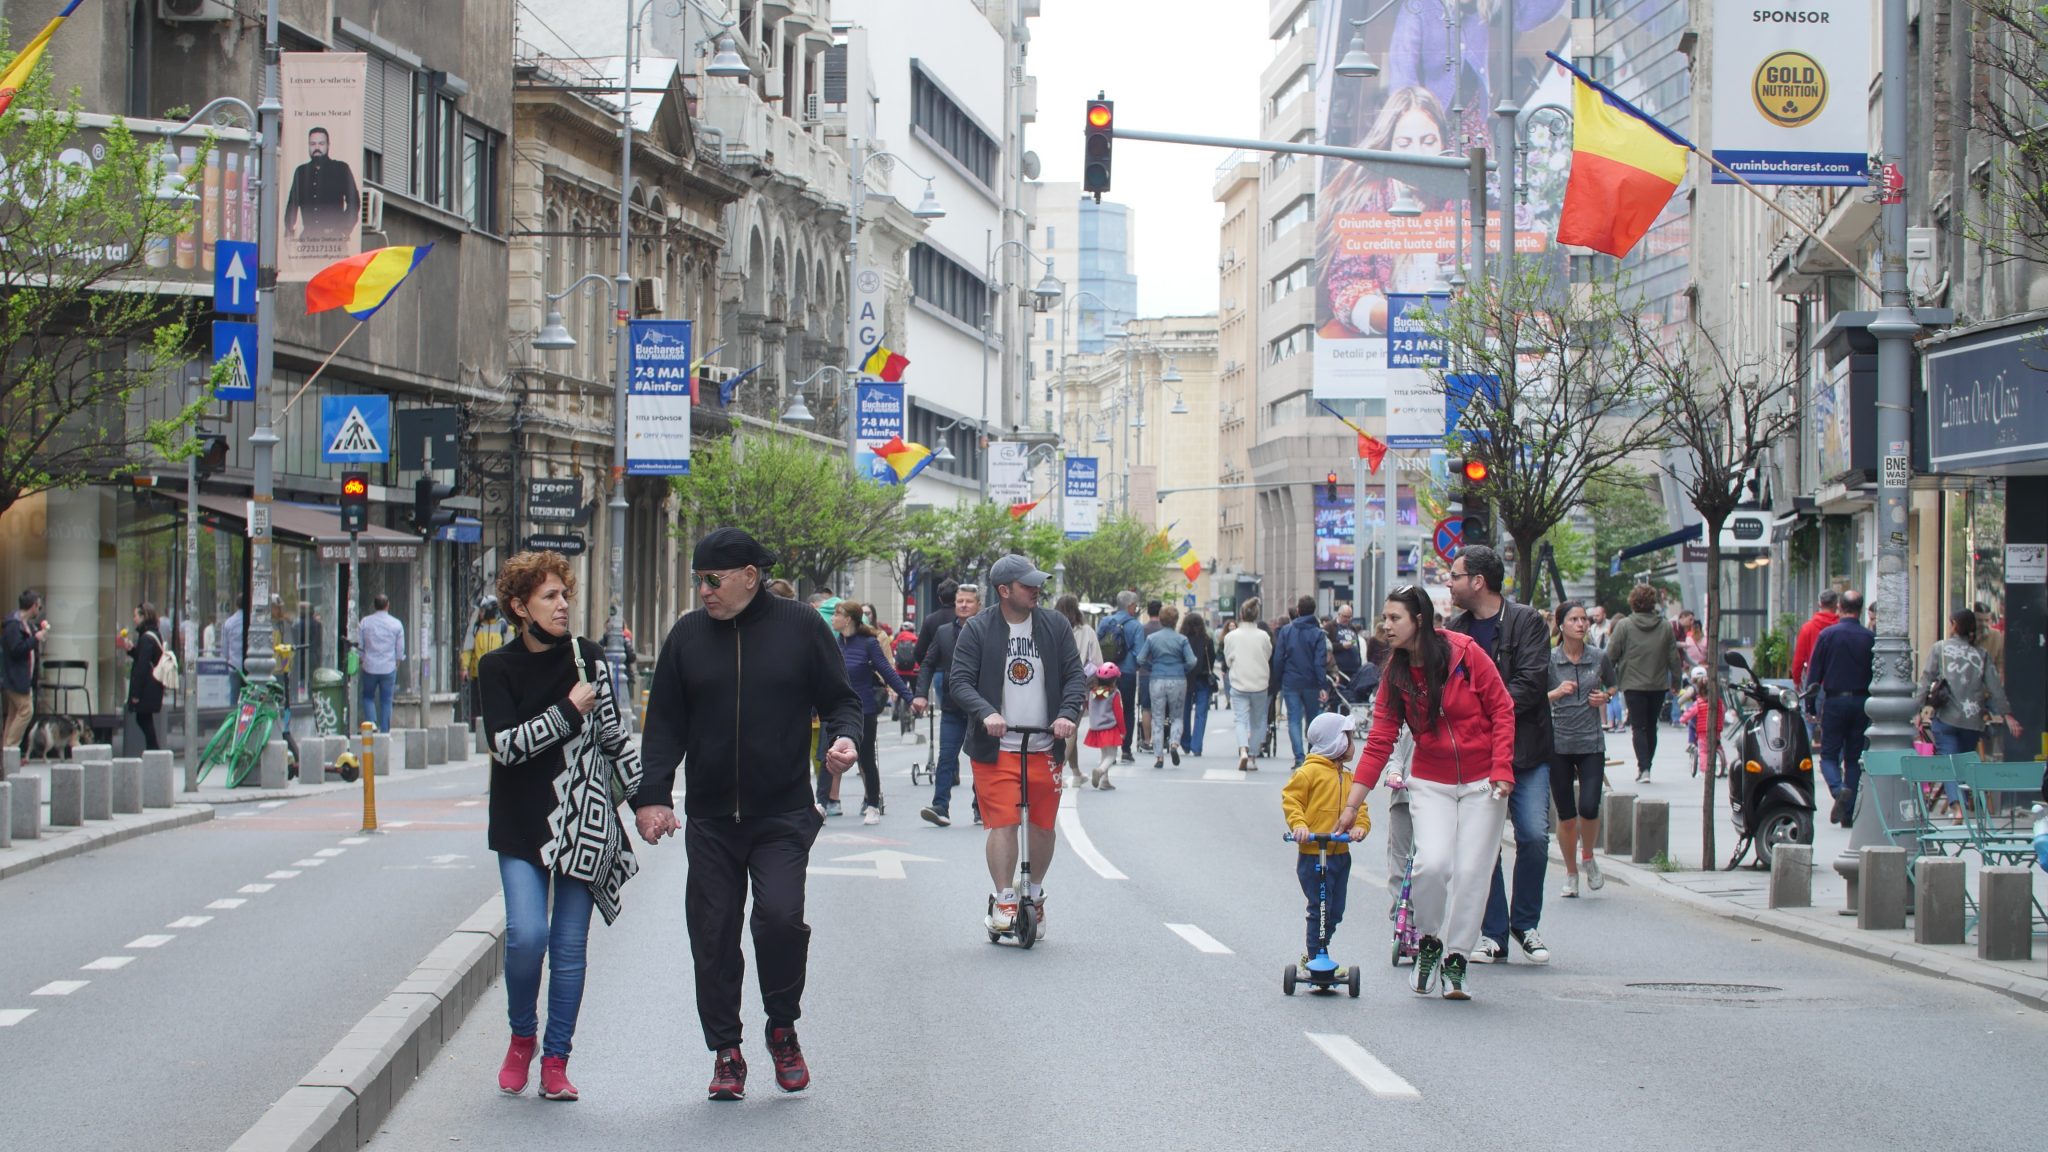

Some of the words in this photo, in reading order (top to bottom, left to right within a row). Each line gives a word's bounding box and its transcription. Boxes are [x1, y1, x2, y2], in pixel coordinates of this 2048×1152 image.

[1752, 11, 1830, 23] SPONSOR
[1766, 66, 1815, 84] GOLD
[1762, 85, 1819, 97] NUTRITION
[1730, 160, 1849, 172] runinbucharest.com
[1346, 239, 1361, 250] Cu
[1363, 237, 1402, 250] credite
[1403, 237, 1434, 250] luate
[1435, 237, 1467, 250] diret
[635, 343, 685, 355] Bucharest
[1393, 340, 1413, 352] 7-8
[635, 366, 655, 379] 7-8
[657, 367, 685, 379] MAI
[634, 381, 685, 392] #AimFar
[861, 417, 878, 428] 7-8
[879, 417, 900, 428] MAI
[1885, 457, 1906, 471] BNE
[1885, 479, 1907, 487] HERE
